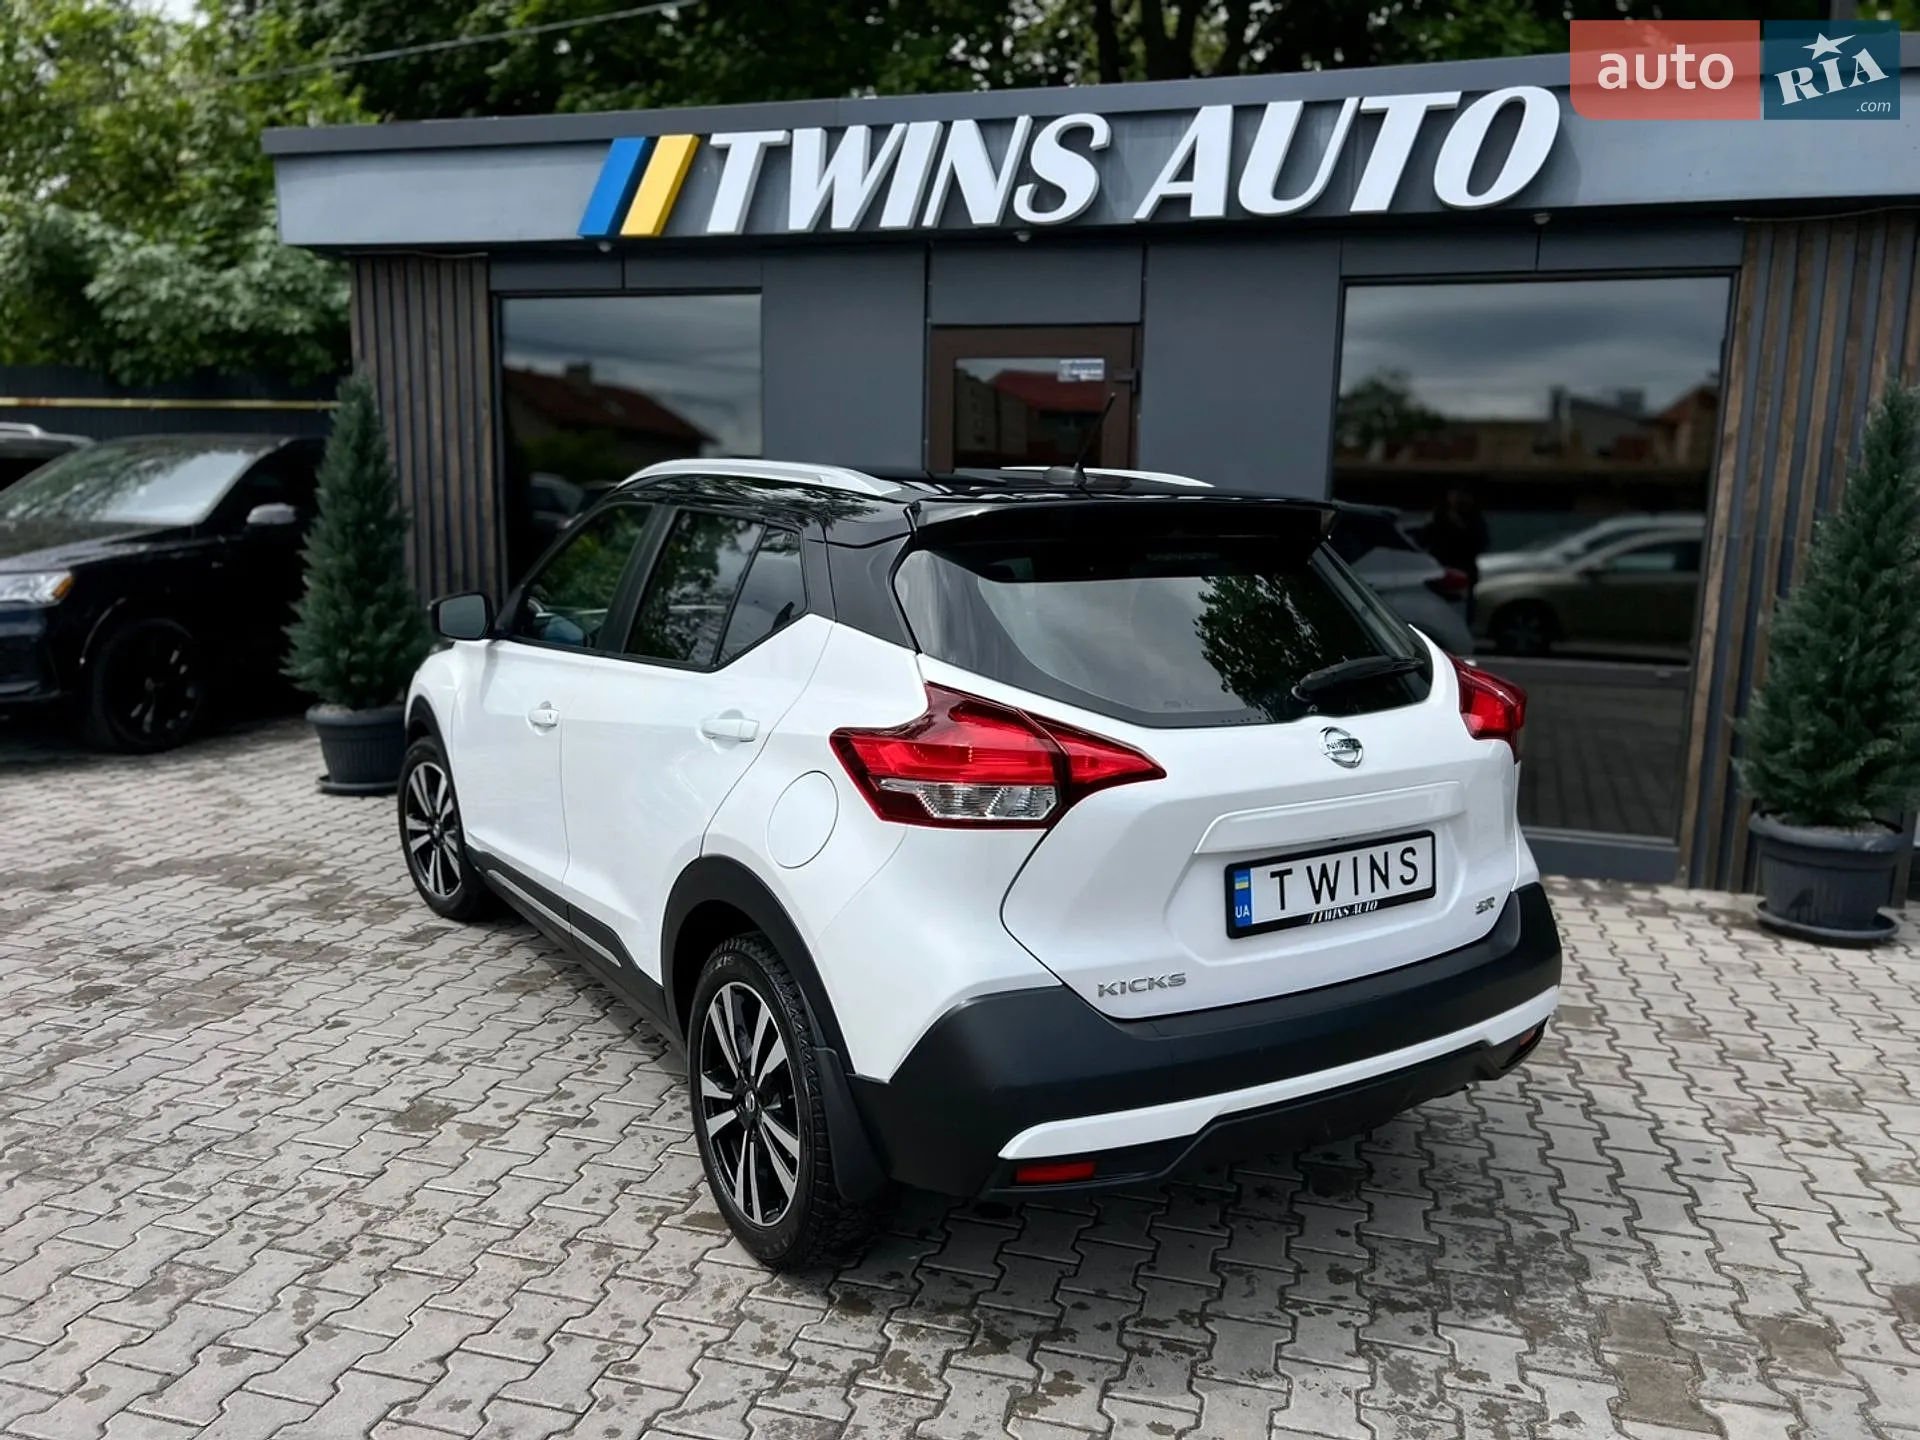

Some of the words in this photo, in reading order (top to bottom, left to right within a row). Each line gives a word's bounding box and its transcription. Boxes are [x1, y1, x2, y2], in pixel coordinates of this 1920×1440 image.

[705, 112, 1112, 235] TWINS
[1132, 85, 1561, 223] AUTO
[1234, 903, 1251, 919] UA
[1318, 907, 1350, 922] TWINS
[1352, 901, 1378, 915] AUTO
[1097, 972, 1187, 998] KICKS
